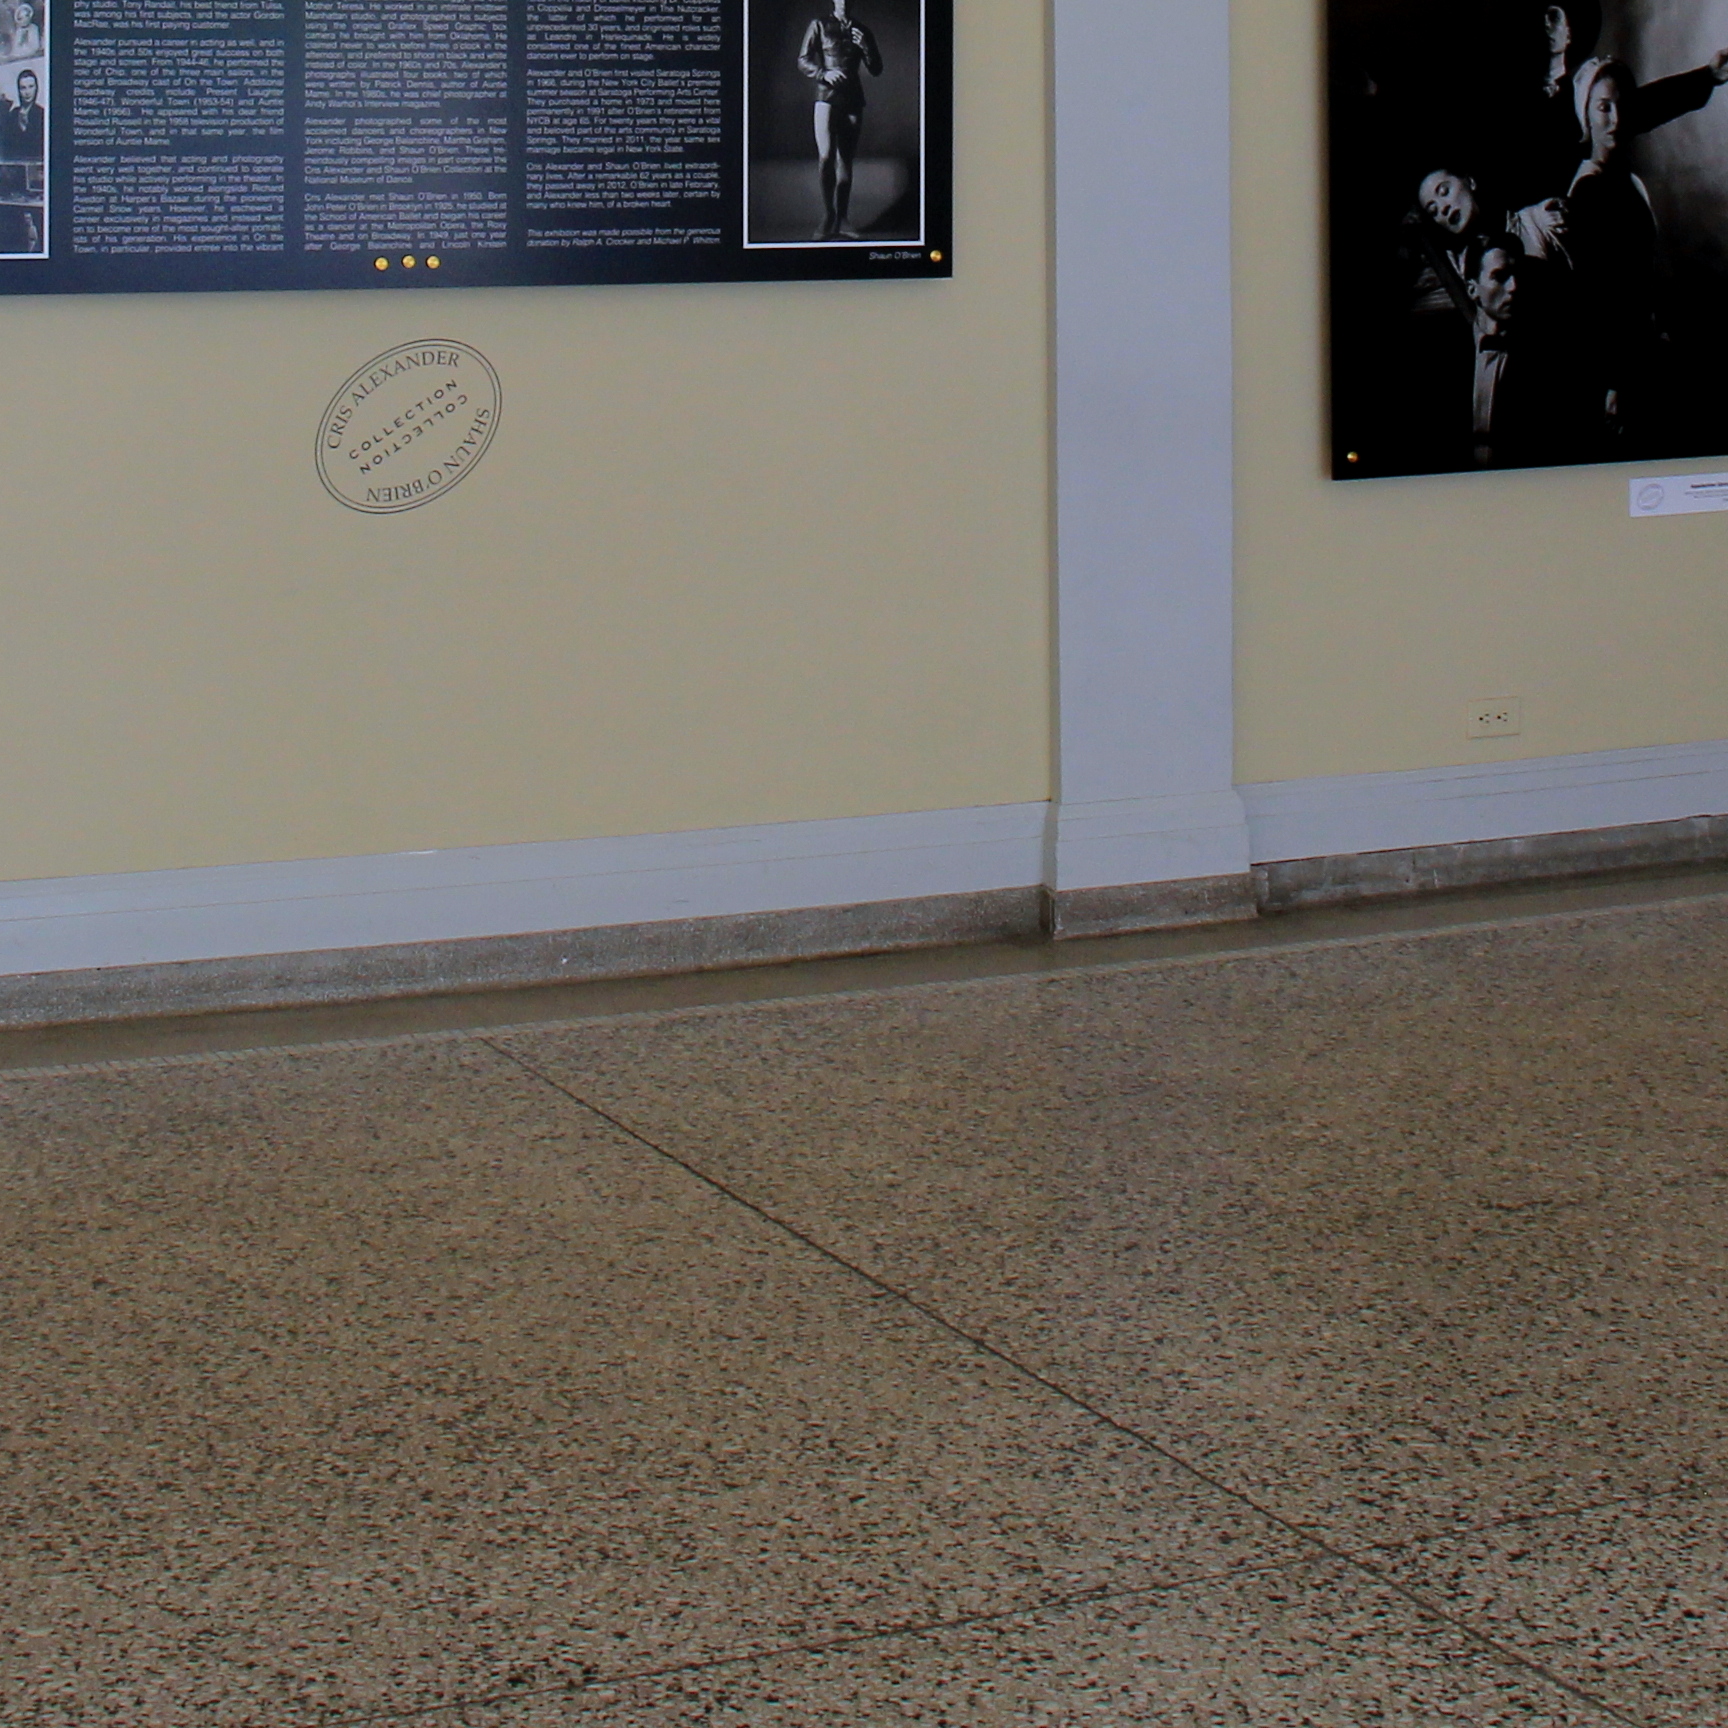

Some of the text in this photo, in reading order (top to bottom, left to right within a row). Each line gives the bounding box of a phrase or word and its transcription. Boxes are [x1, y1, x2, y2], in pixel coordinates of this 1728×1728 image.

[327, 350, 460, 450] CRIS ALEXANDER
[348, 378, 458, 460] COLLECTION
[358, 394, 468, 475] COLLECTION
[366, 407, 491, 503] SHAUN O'BRIEN
